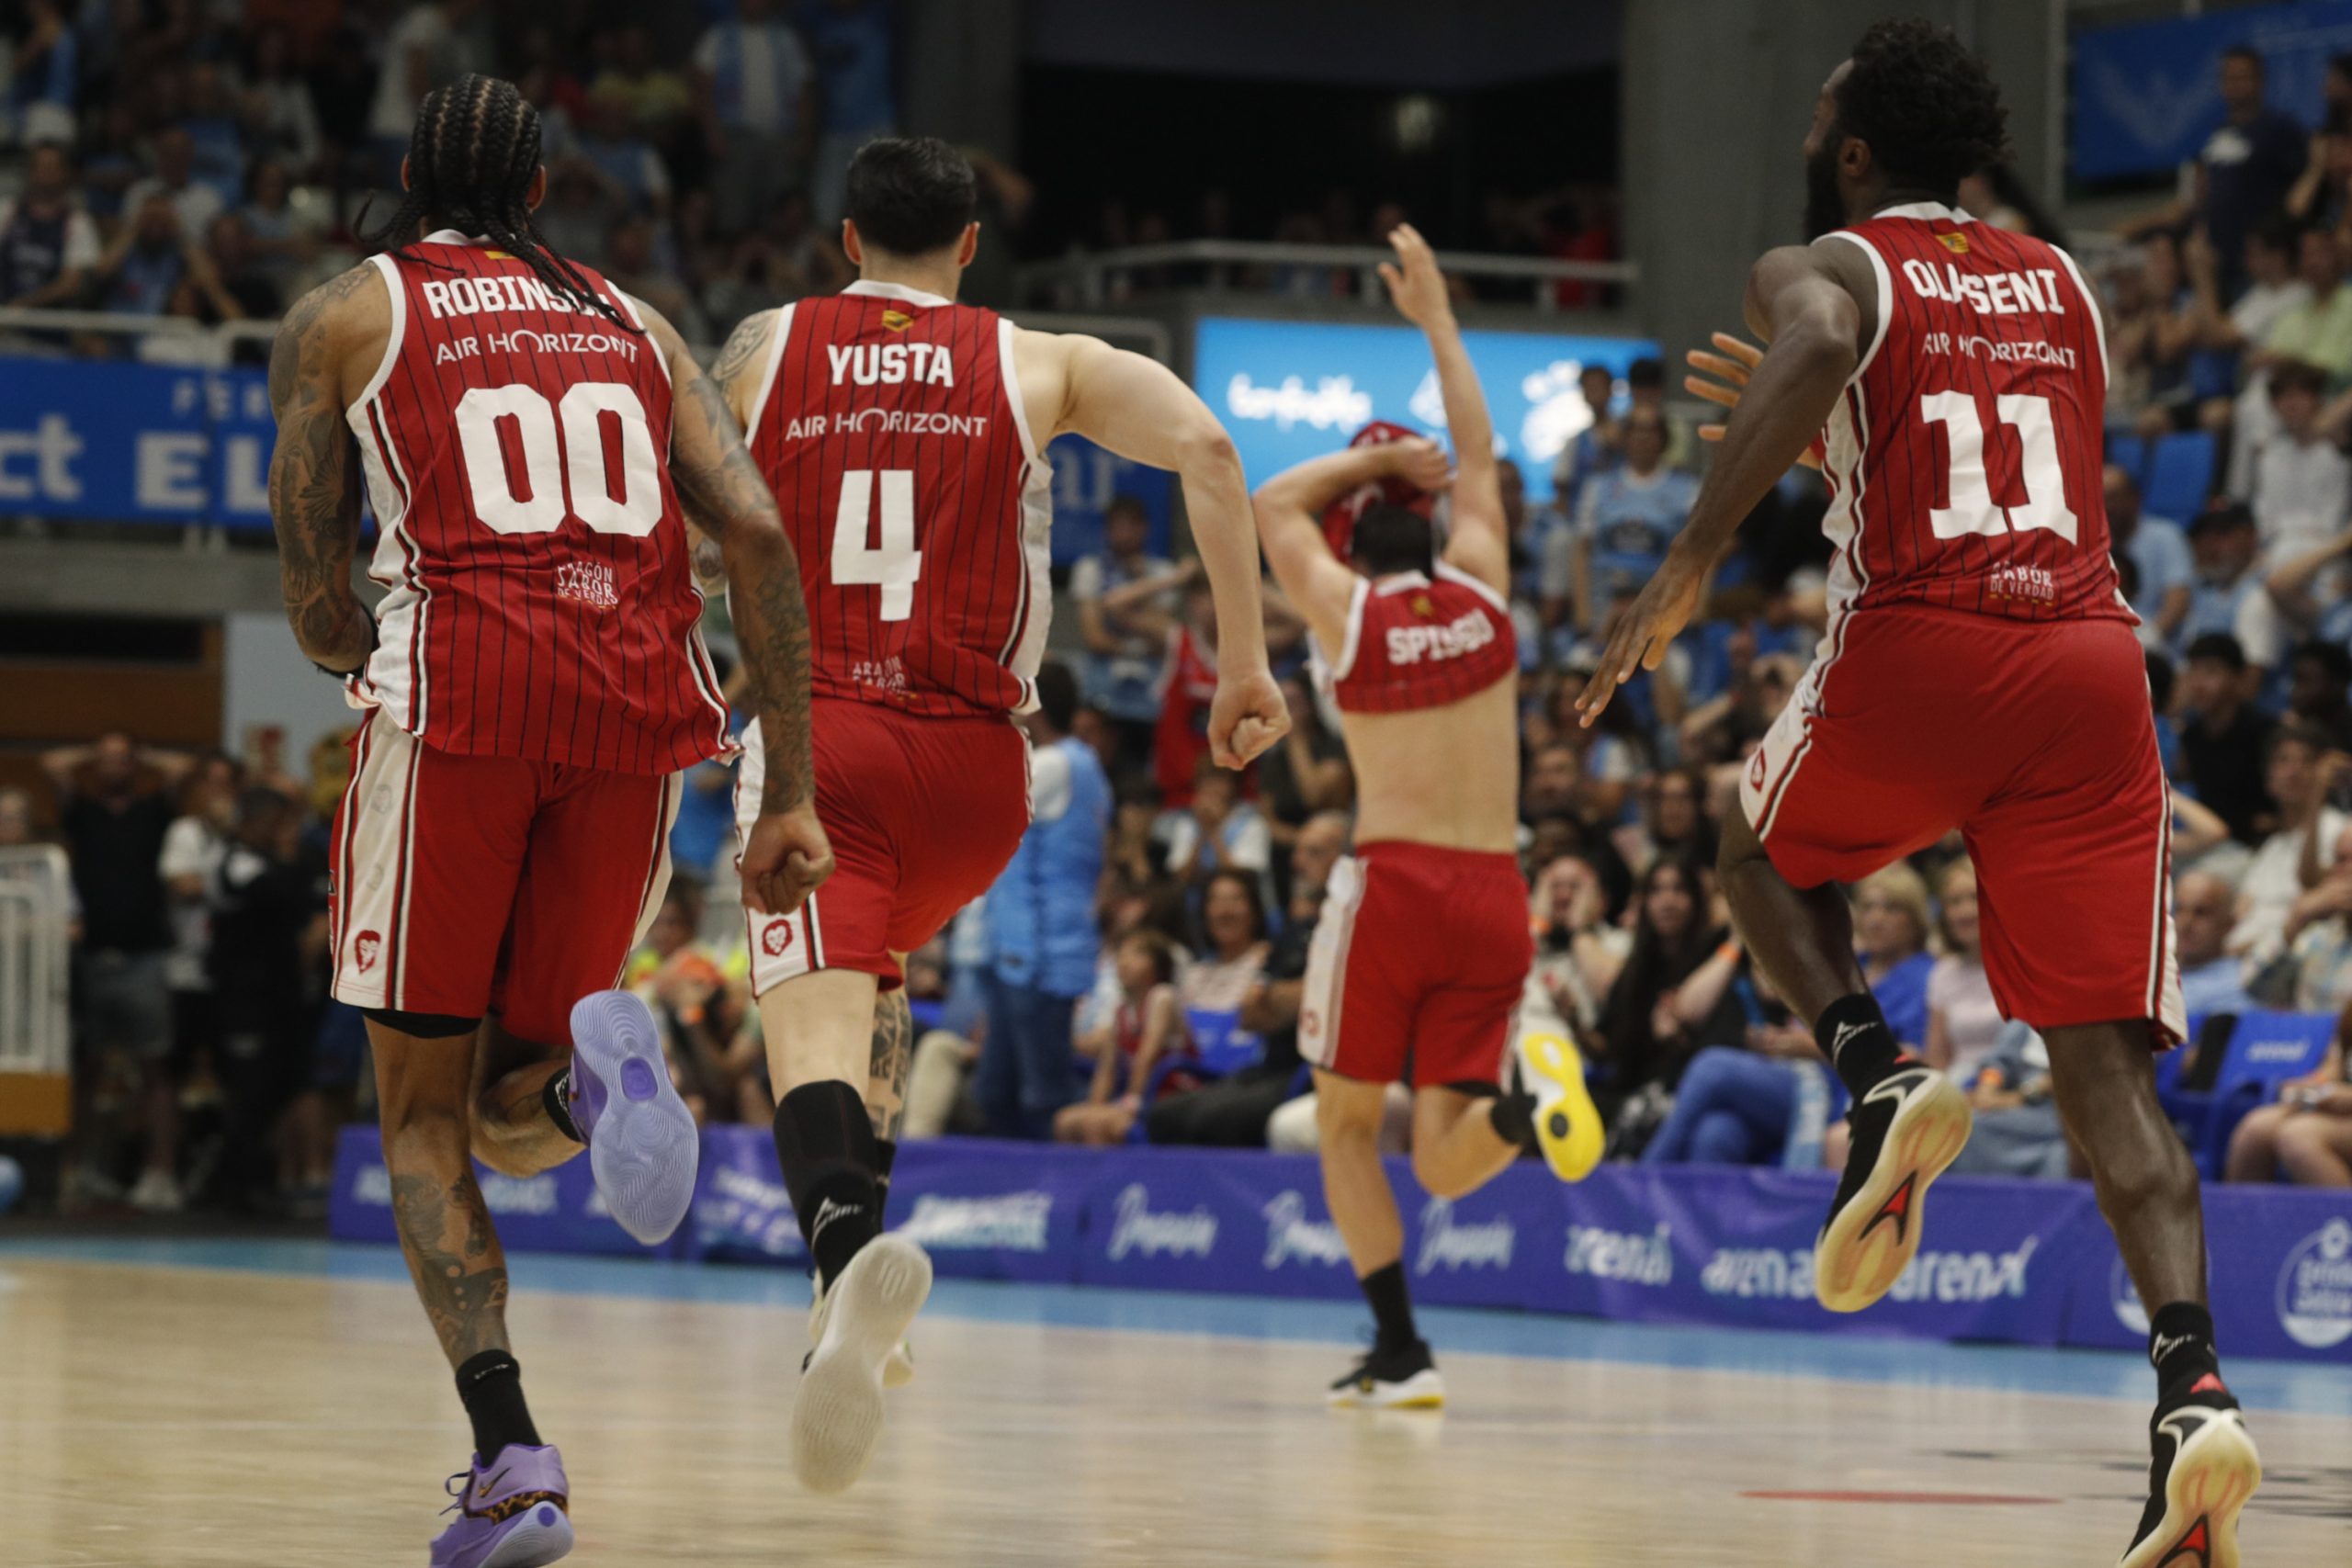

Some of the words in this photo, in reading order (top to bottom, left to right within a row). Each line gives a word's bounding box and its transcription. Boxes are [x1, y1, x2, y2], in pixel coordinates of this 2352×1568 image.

[435, 336, 481, 366] AIR
[487, 329, 639, 364] HORIZONT
[828, 342, 955, 389] YUSTA
[1922, 332, 1951, 356] AIR
[1958, 333, 2076, 370] HORIZONT
[786, 415, 828, 441] AIR
[833, 408, 988, 437] HORIZONT
[454, 381, 663, 538] 00
[1920, 389, 2078, 547] 11
[831, 469, 922, 623] 4
